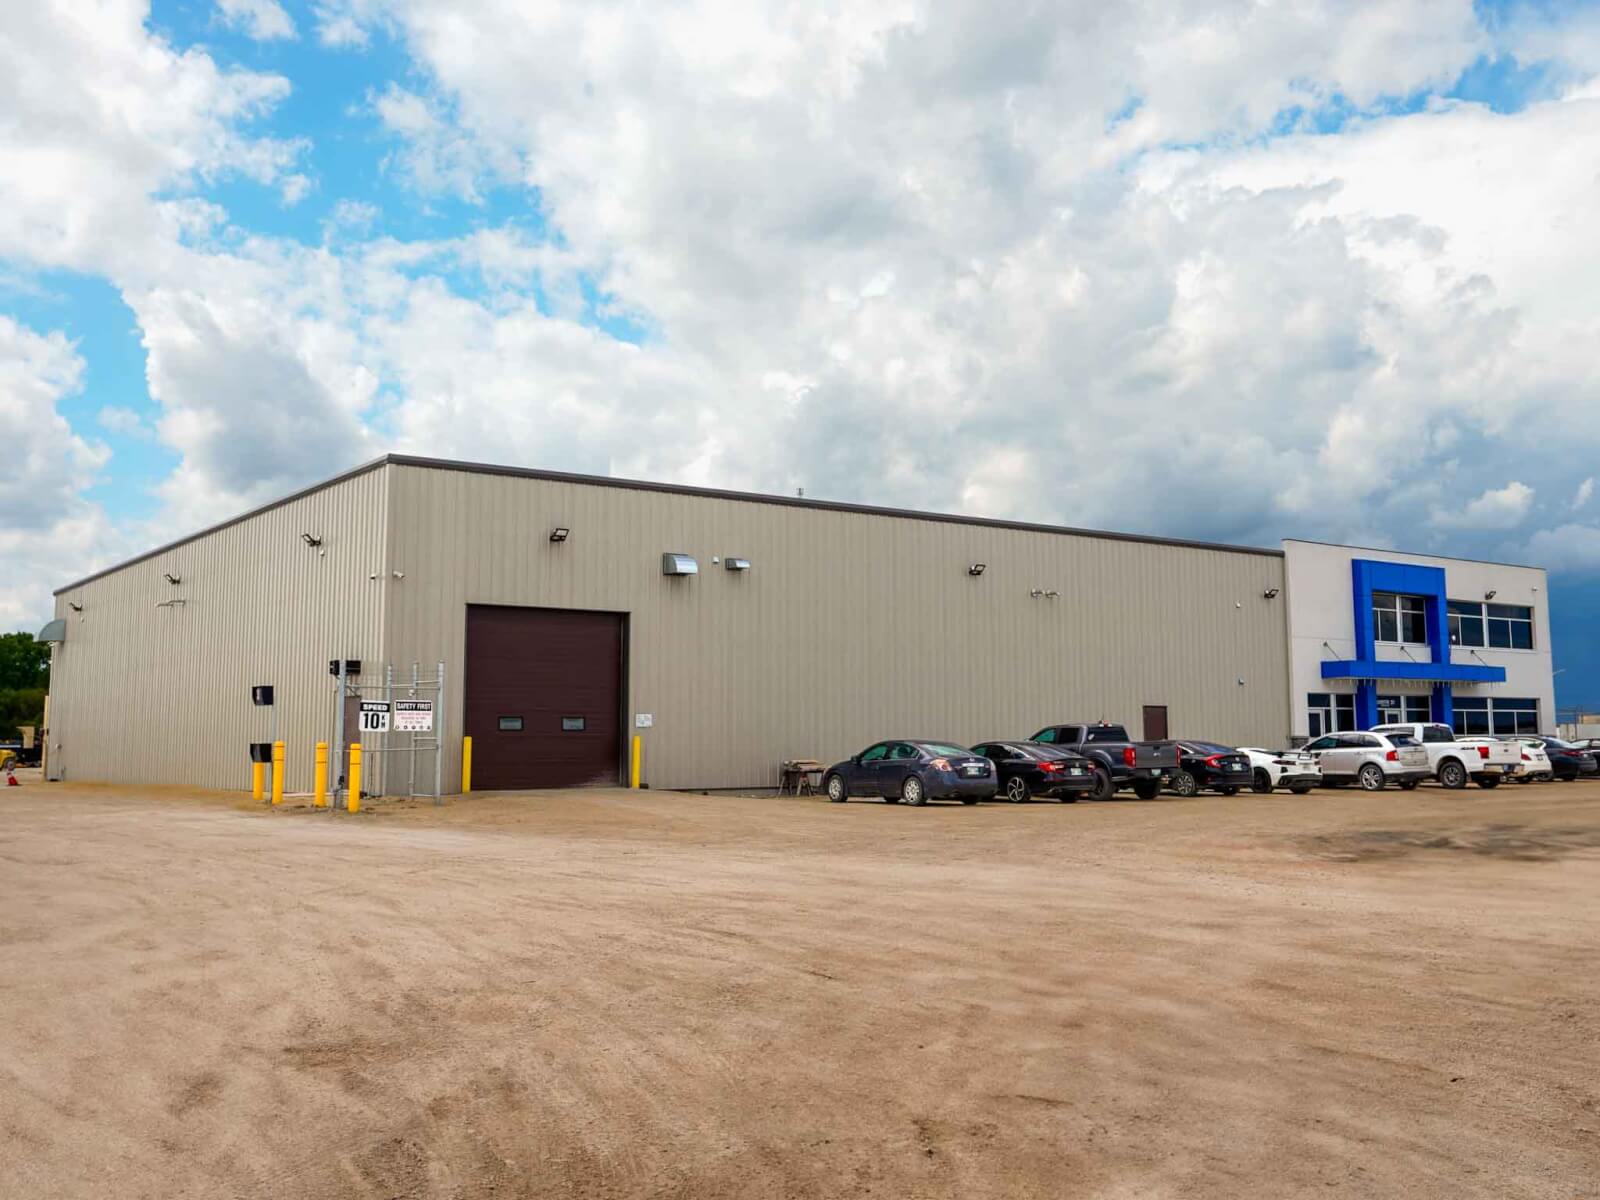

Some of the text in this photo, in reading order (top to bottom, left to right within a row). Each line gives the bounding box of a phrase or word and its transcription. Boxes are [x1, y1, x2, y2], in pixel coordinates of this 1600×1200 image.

[363, 703, 388, 711] SPEED
[397, 702, 416, 710] SAFETY
[364, 713, 380, 729] 10
